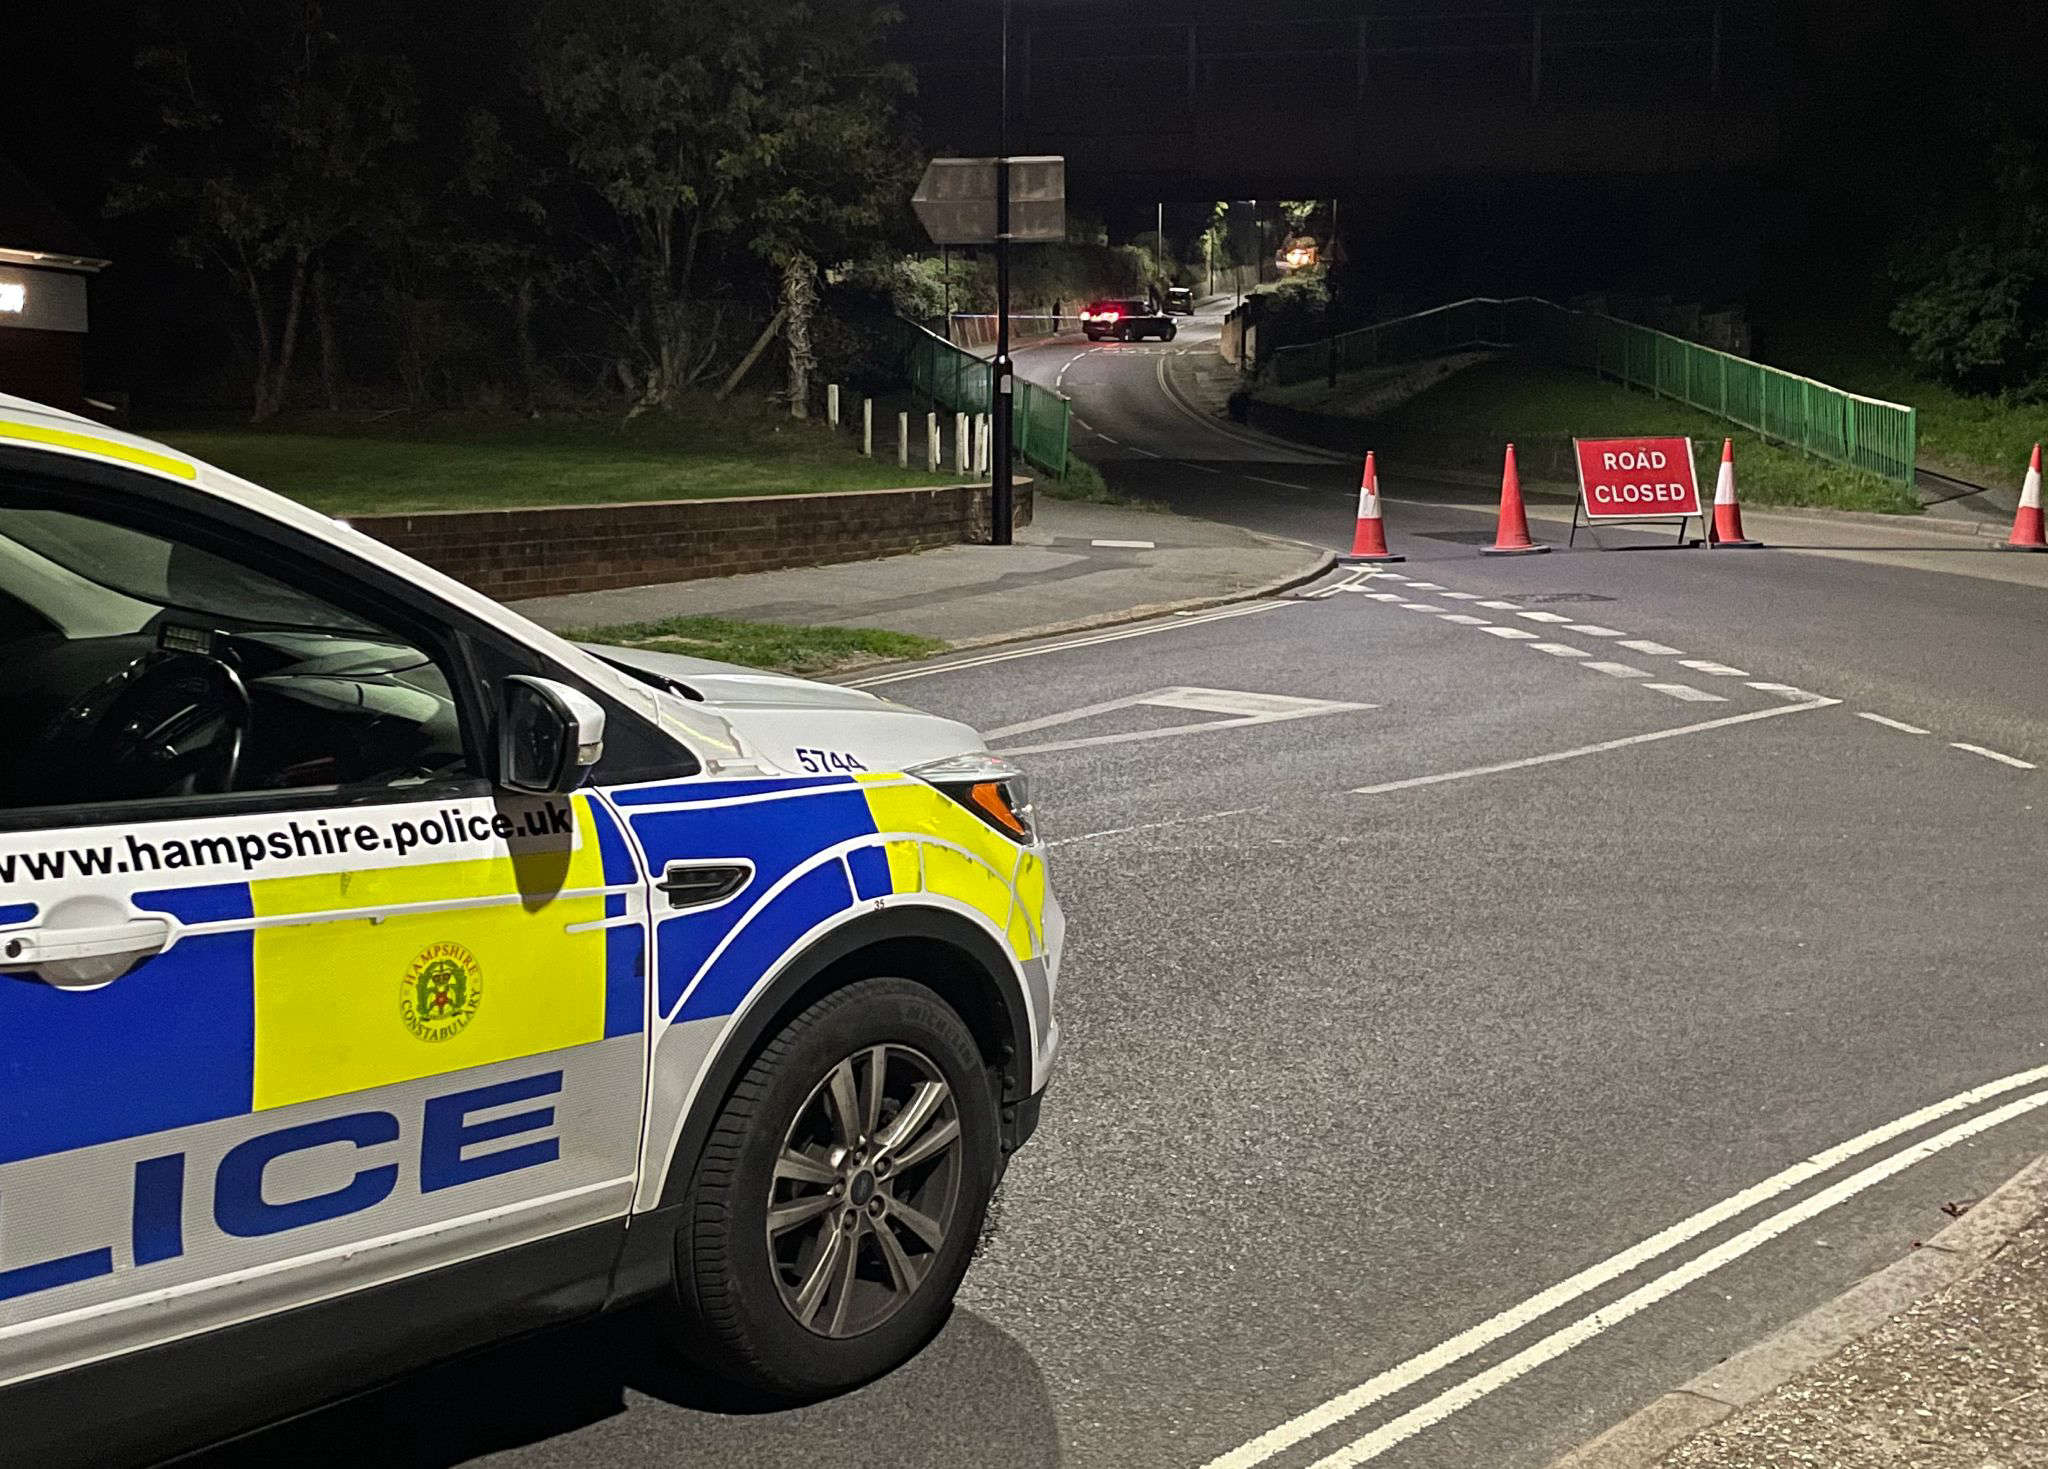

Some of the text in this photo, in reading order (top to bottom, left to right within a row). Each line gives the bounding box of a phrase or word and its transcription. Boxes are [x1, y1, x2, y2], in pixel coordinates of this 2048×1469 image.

[1603, 451, 1667, 470] ROAD
[1594, 483, 1686, 503] CLOSED
[795, 747, 869, 773] 5744
[404, 943, 478, 985] HAMPSHIRE
[401, 988, 481, 1041] CONSTABULARY
